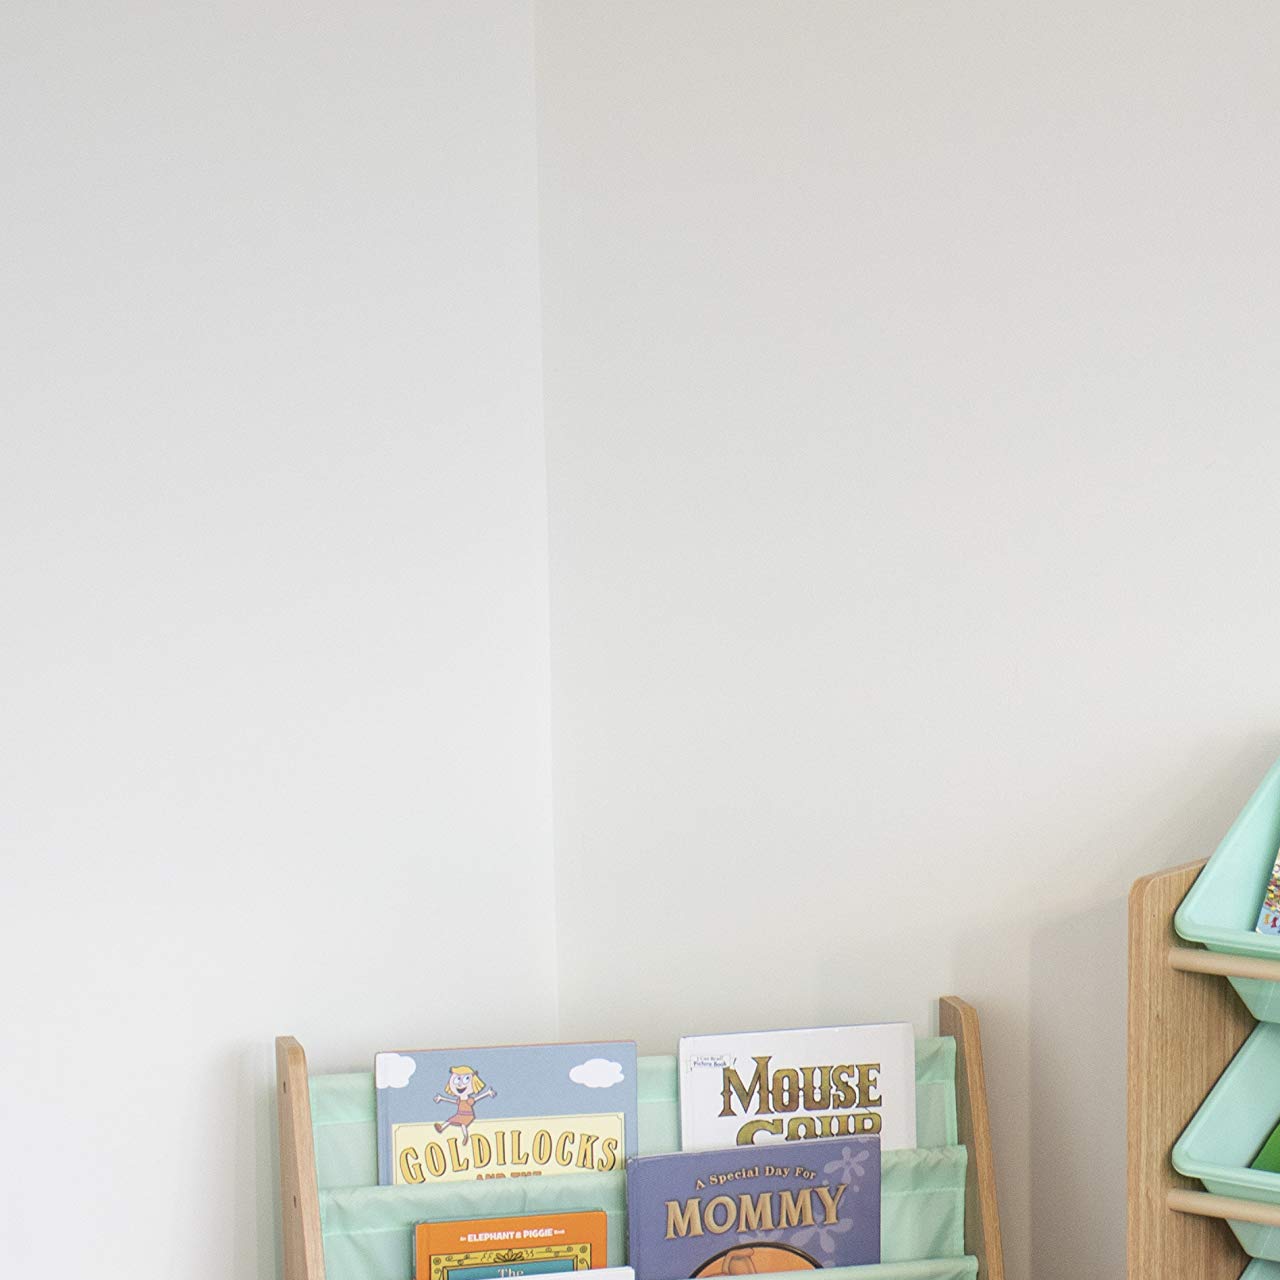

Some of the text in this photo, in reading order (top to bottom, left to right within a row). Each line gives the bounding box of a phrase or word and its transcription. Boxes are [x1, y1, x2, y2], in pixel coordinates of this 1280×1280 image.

[718, 1055, 882, 1118] MOUSE
[399, 1129, 619, 1186] GOLDILOCKS
[695, 1165, 817, 1190] A Special Day For
[467, 1231, 515, 1242] ELEPHANT
[515, 1231, 522, 1239] &
[523, 1228, 553, 1239] PIGGIE
[664, 1183, 847, 1240] MOMMY
